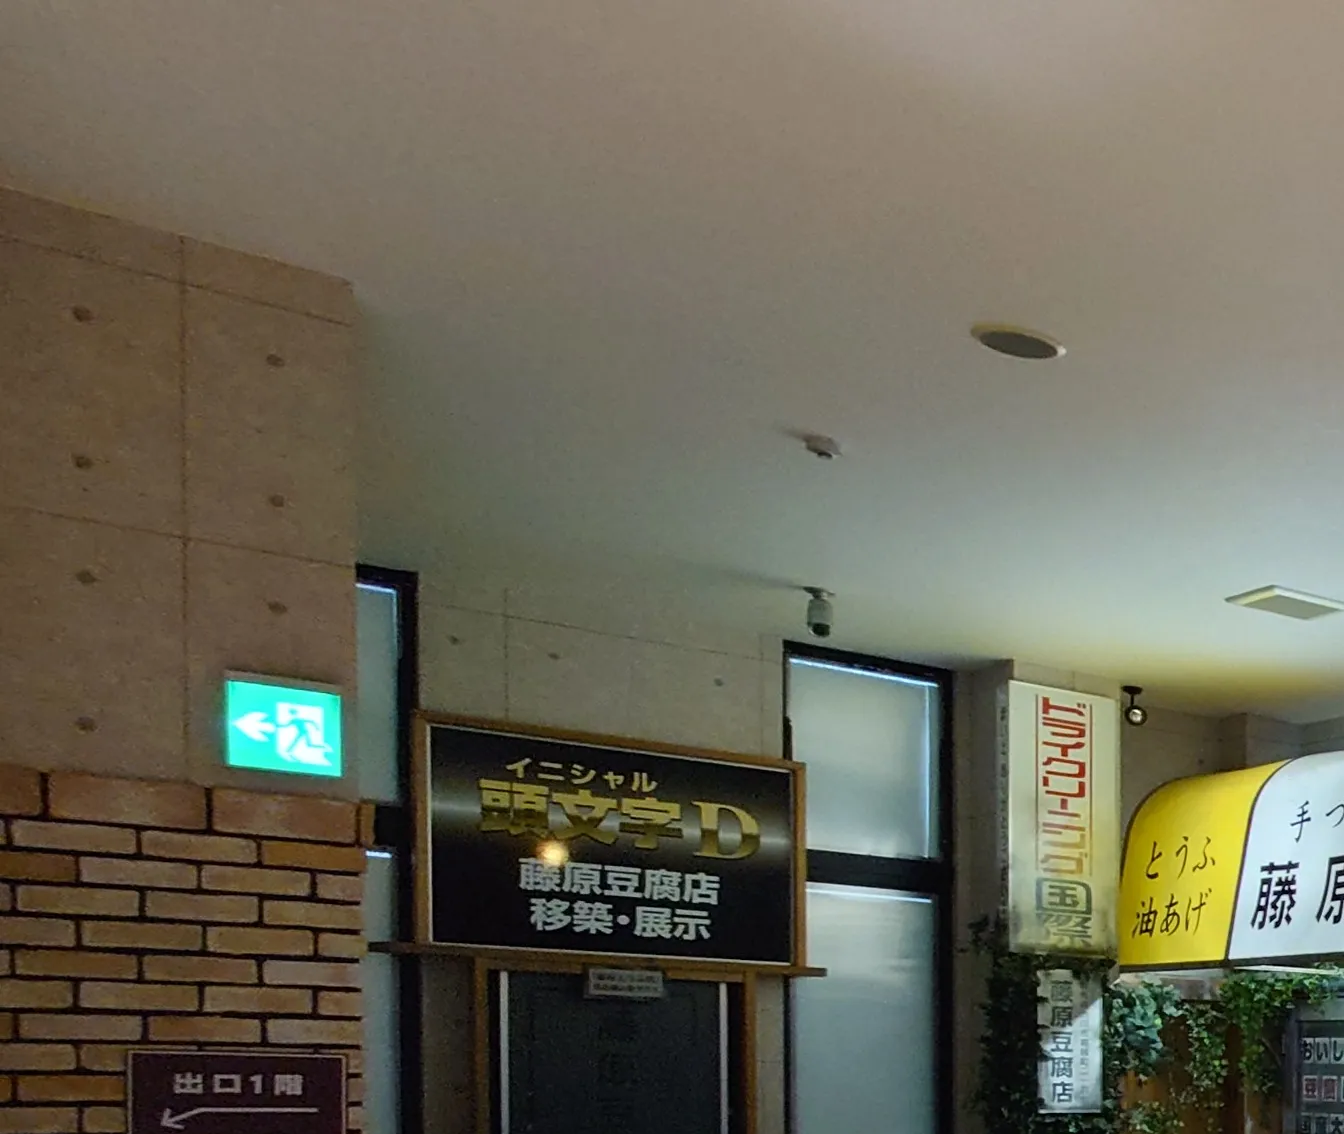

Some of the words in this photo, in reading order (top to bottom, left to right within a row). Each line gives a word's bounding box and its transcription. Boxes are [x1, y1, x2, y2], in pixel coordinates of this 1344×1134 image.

[505, 757, 658, 793] イニシャル
[1041, 696, 1089, 872] ドライクリーニング
[477, 777, 761, 860] 頭文字D
[518, 857, 721, 906] 藤原豆腐店
[1144, 835, 1217, 881] とうふ
[529, 898, 711, 941] 移築・展示
[1130, 887, 1214, 941] 油あげ
[172, 1073, 303, 1097] 出口1階
